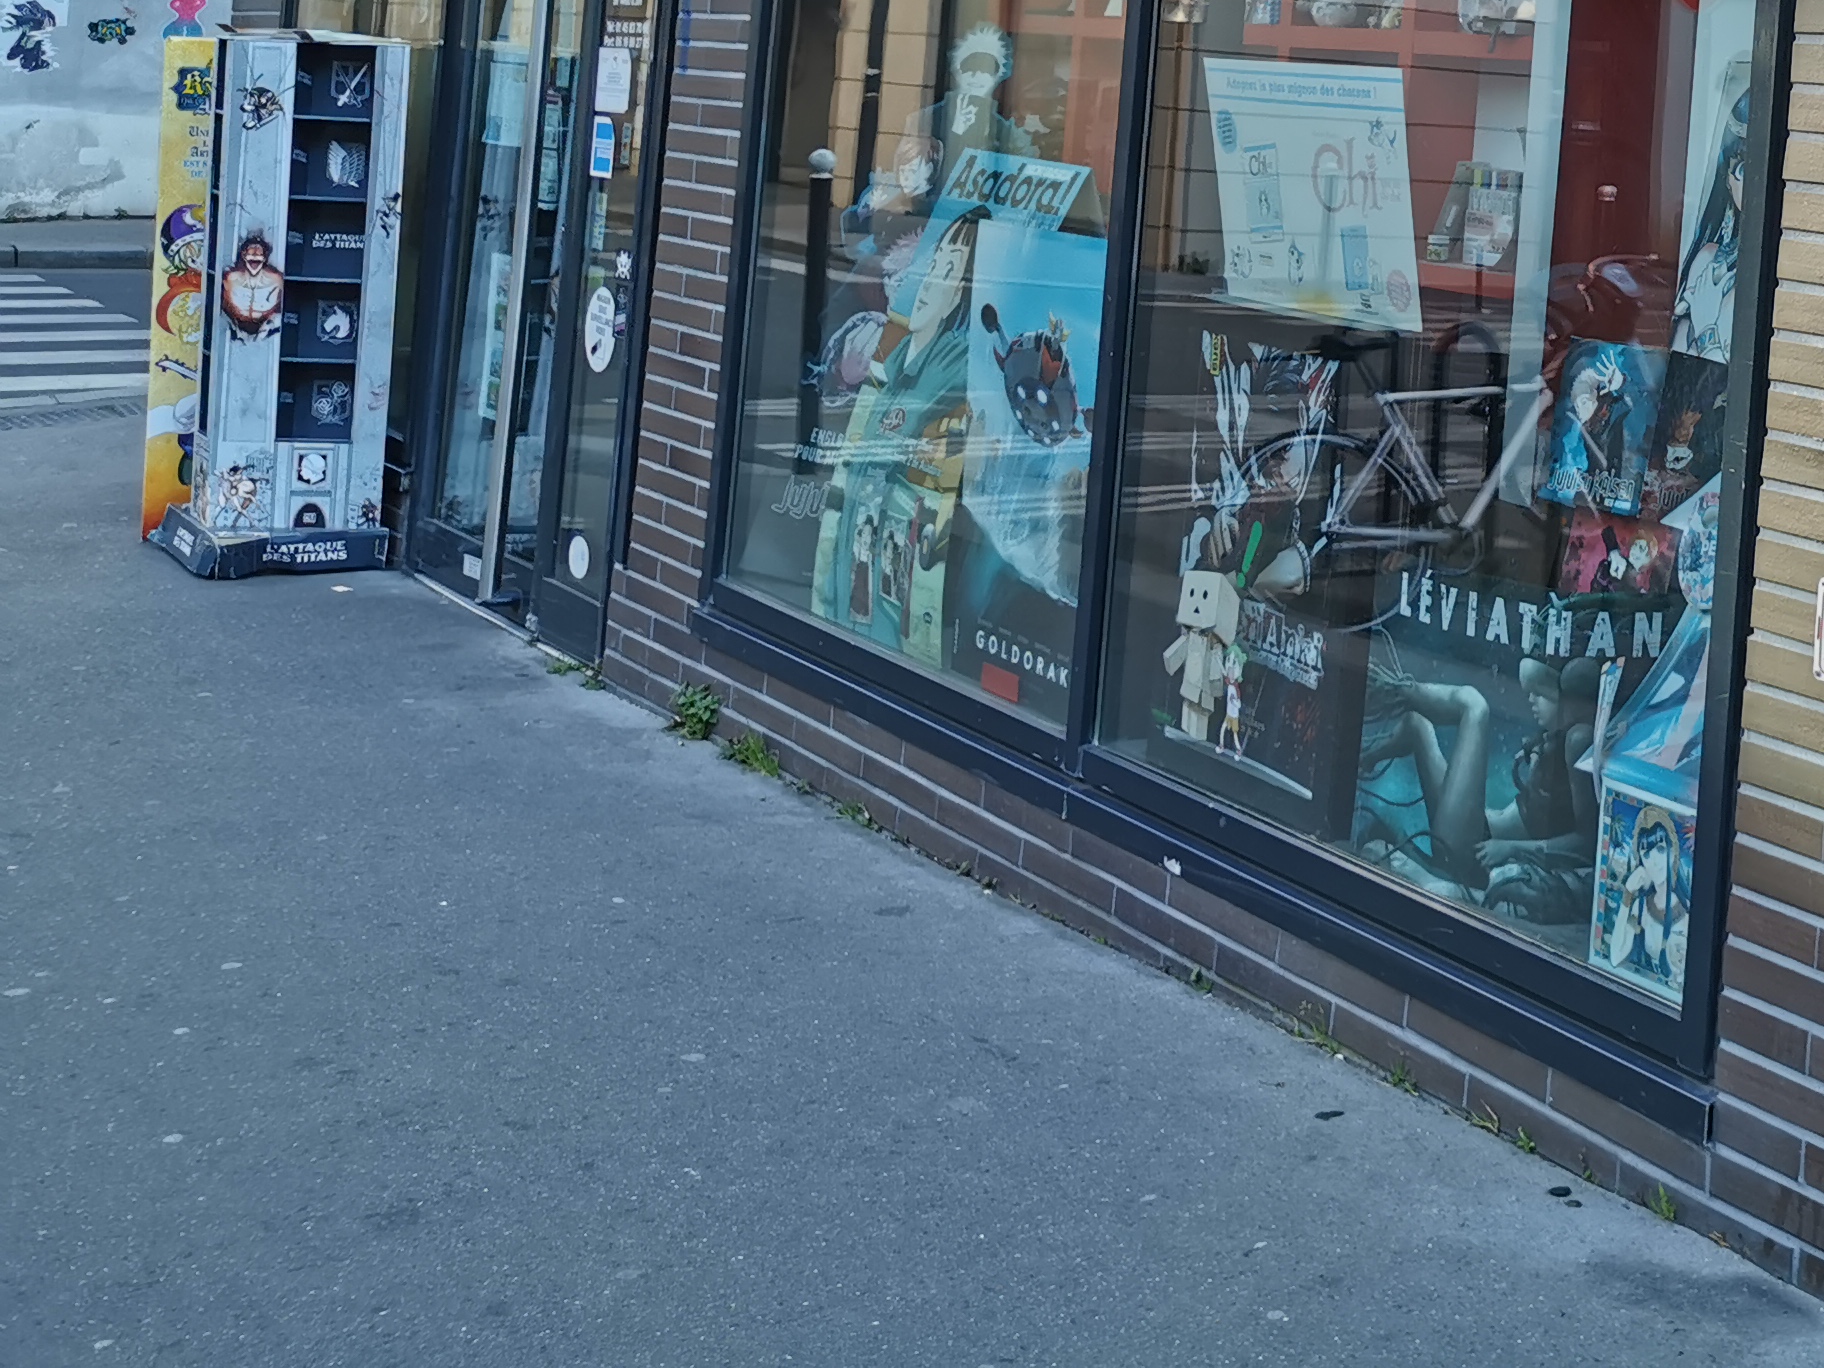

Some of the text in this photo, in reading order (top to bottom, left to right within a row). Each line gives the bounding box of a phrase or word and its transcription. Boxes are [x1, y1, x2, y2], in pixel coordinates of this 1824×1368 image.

[948, 154, 1082, 217] Asadora!
[314, 232, 365, 242] L'ATTAQU
[335, 239, 365, 249] TITAN
[266, 540, 347, 554] L'ATTAQUE
[262, 550, 348, 563] DES TITANS
[1400, 569, 1663, 658] LÉVIATHAN
[976, 630, 1069, 688] GOLDORAK
